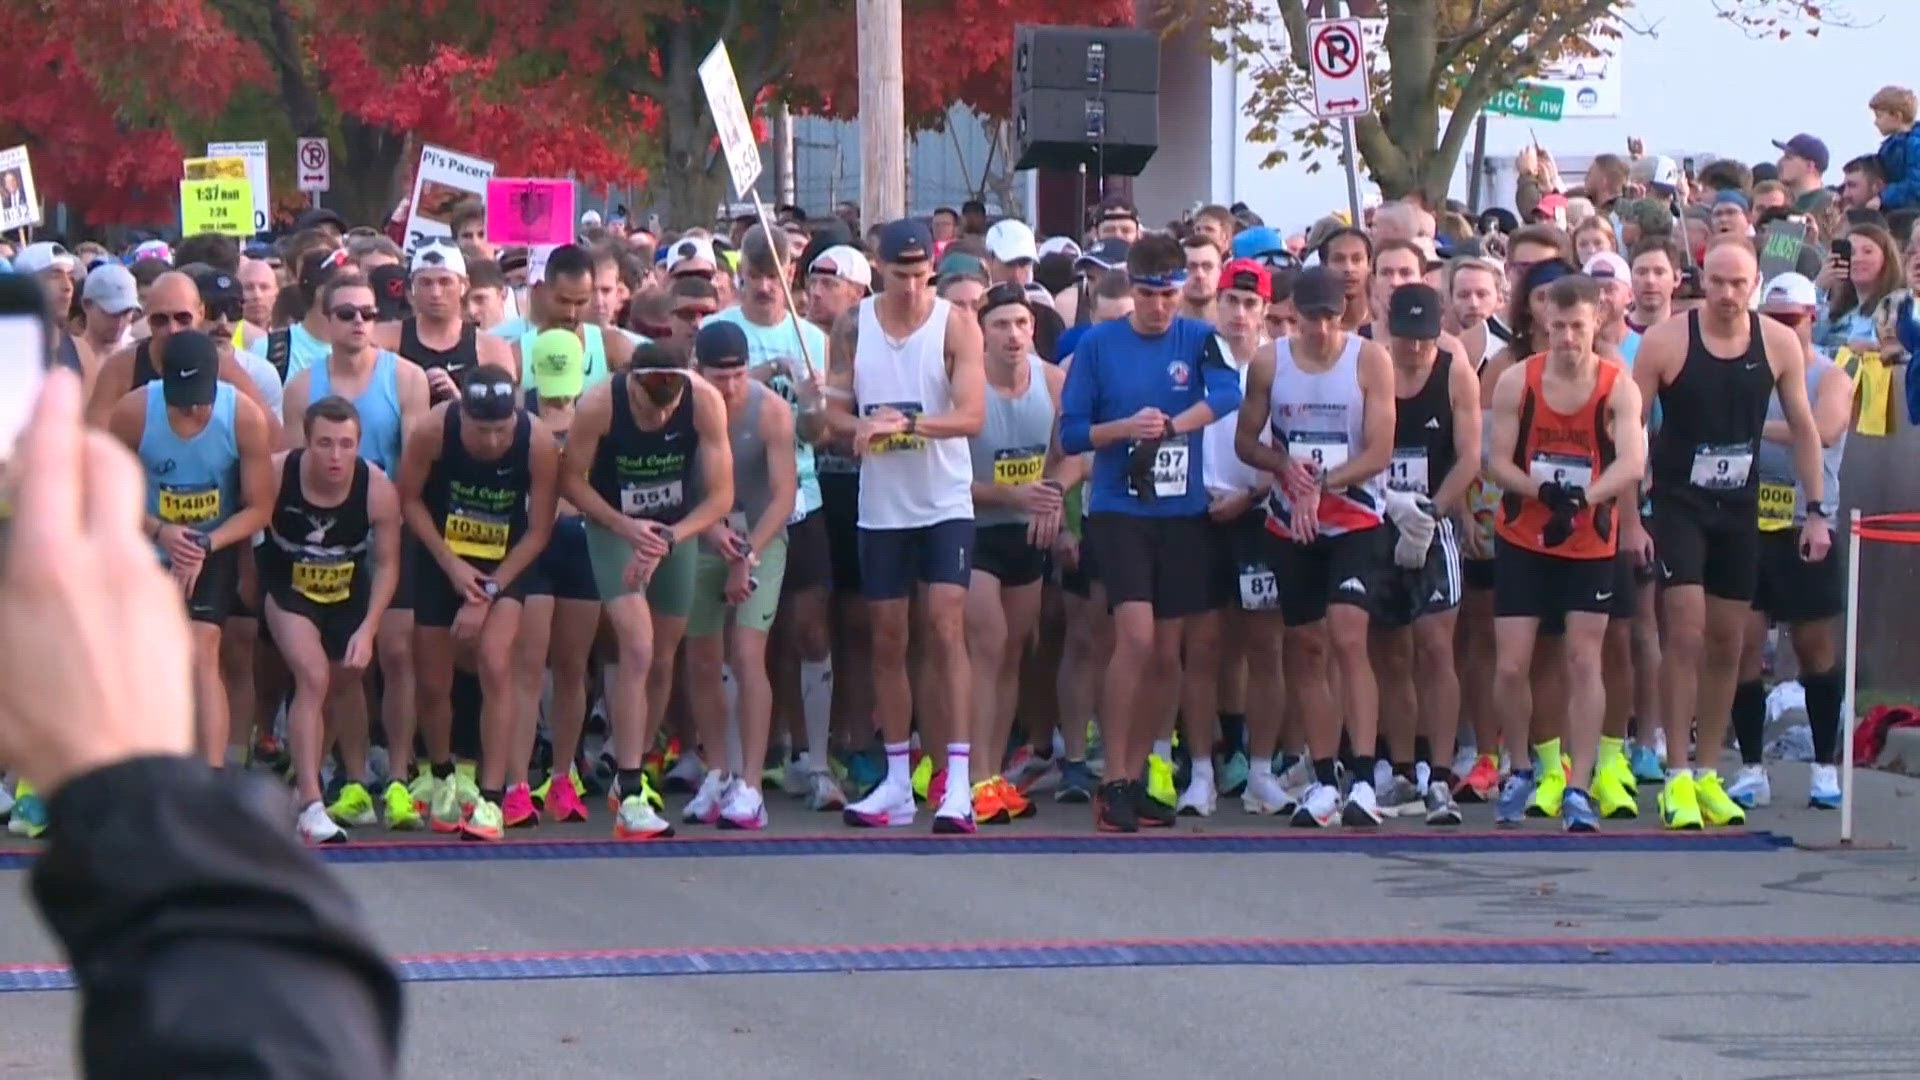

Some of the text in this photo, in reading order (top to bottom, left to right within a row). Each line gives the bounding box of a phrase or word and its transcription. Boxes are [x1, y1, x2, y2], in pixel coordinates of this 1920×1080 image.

[448, 157, 491, 179] Pacers
[196, 185, 219, 202] 1:37
[1716, 459, 1730, 475] 9
